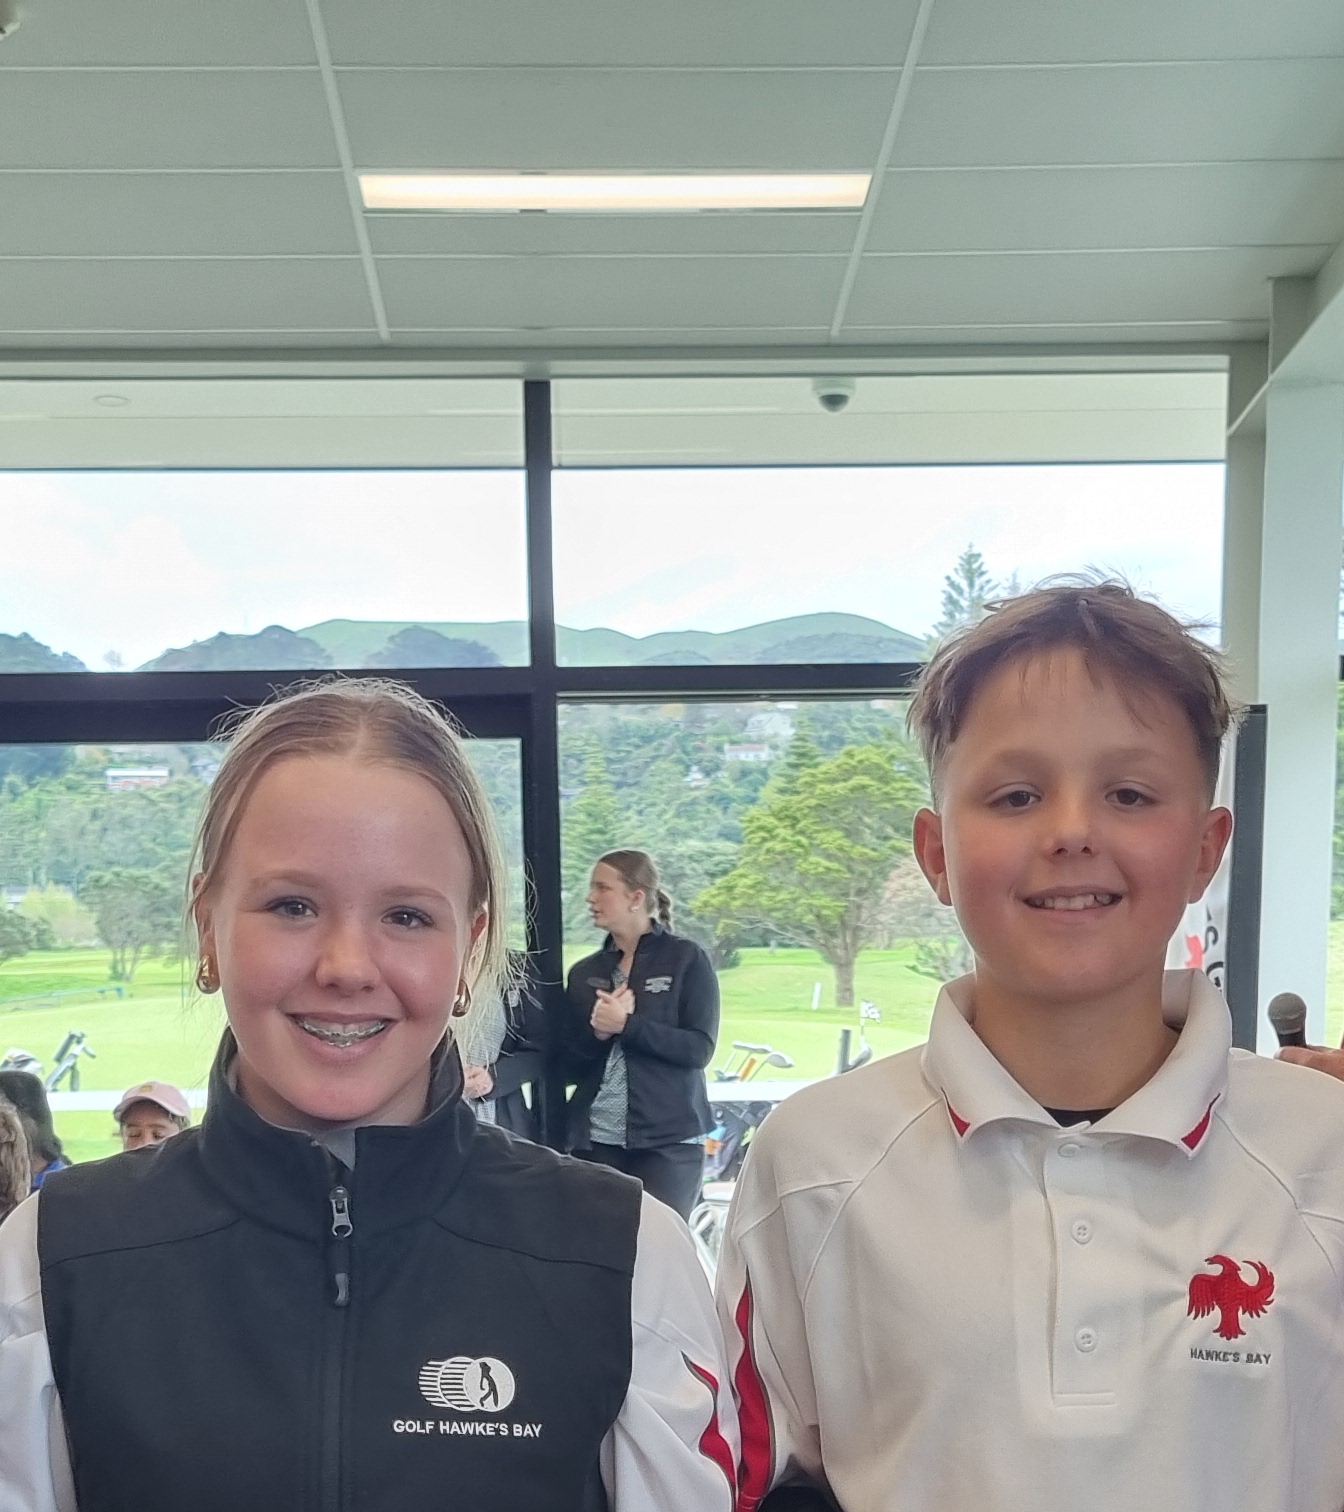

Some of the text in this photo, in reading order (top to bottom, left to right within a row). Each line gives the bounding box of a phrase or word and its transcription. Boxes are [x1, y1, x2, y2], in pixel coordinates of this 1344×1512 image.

[1190, 1347, 1272, 1365] HAWKE'S BAY
[393, 1419, 542, 1437] GOLF HAWKE'S BAY
